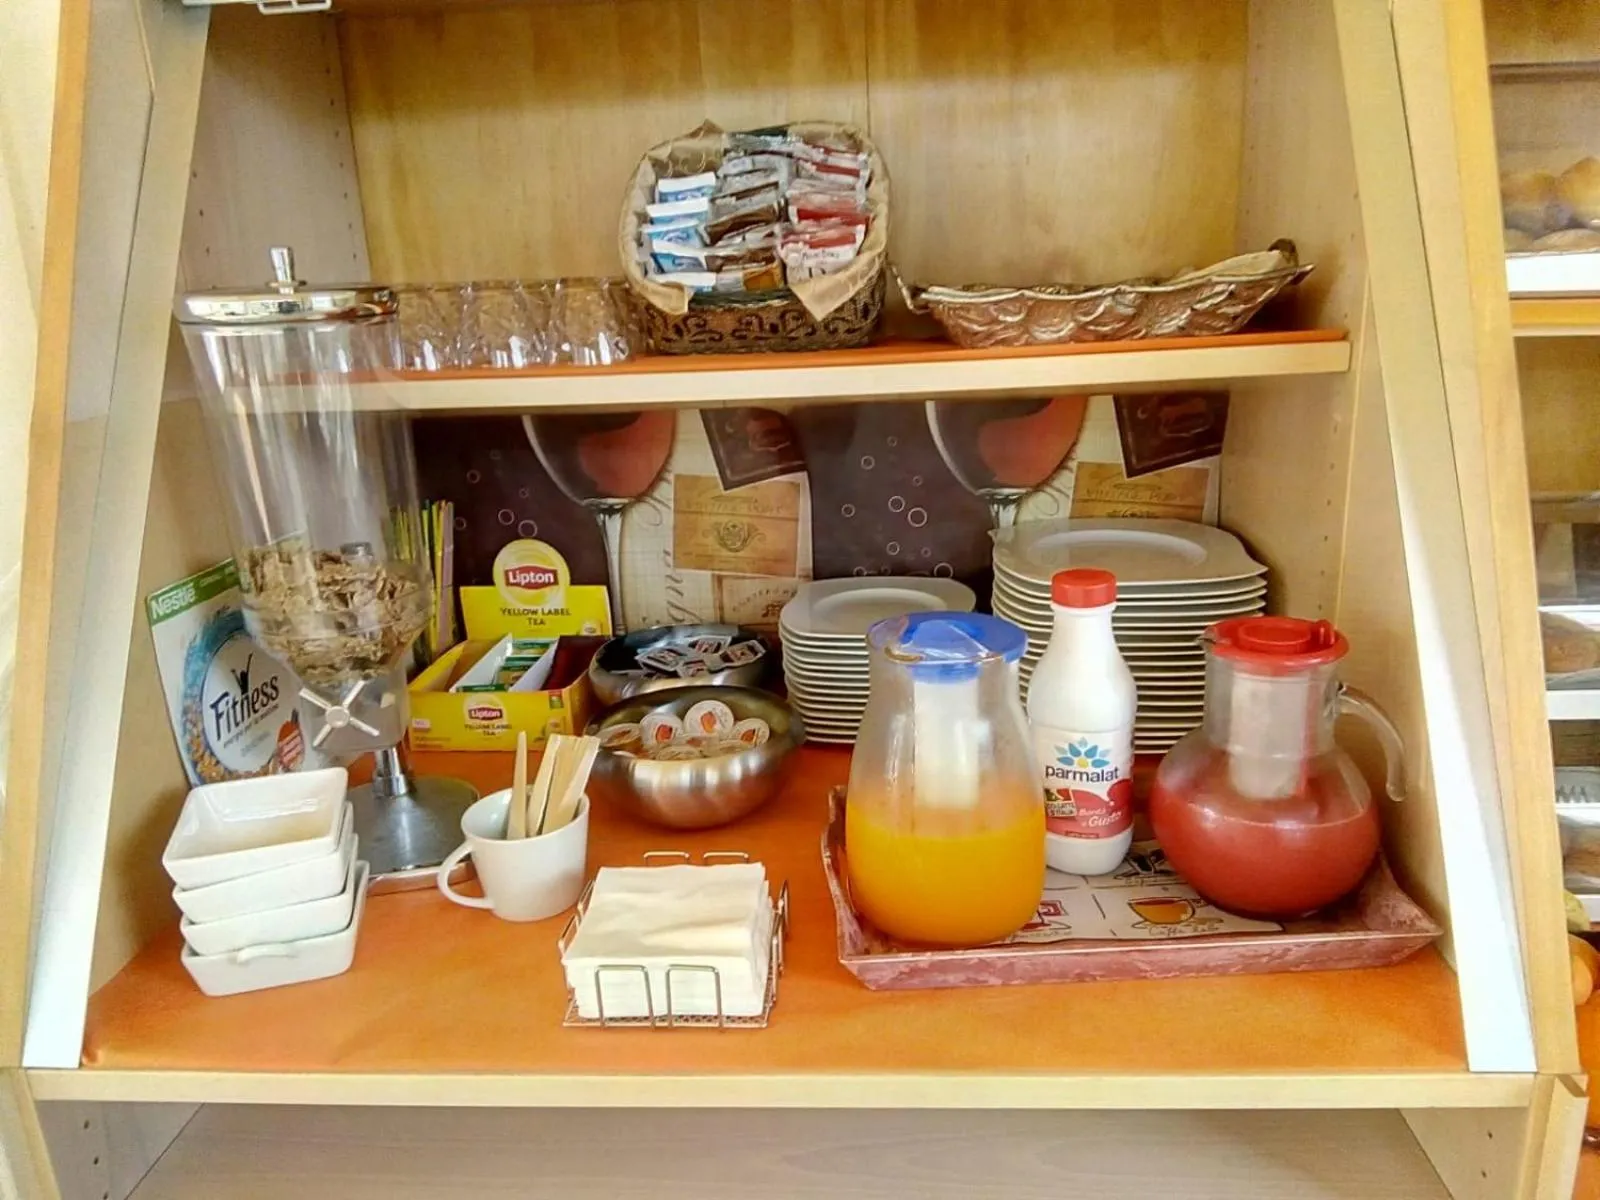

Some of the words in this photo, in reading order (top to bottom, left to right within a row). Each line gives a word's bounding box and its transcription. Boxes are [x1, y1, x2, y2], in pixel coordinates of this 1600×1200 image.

[508, 571, 554, 586] Lipton
[500, 608, 538, 616] YELLOW
[541, 608, 572, 616] LABEL
[527, 618, 546, 626] TEA
[209, 675, 280, 741] Fitness
[471, 709, 500, 718] Lipton
[1045, 766, 1120, 782] parmalat
